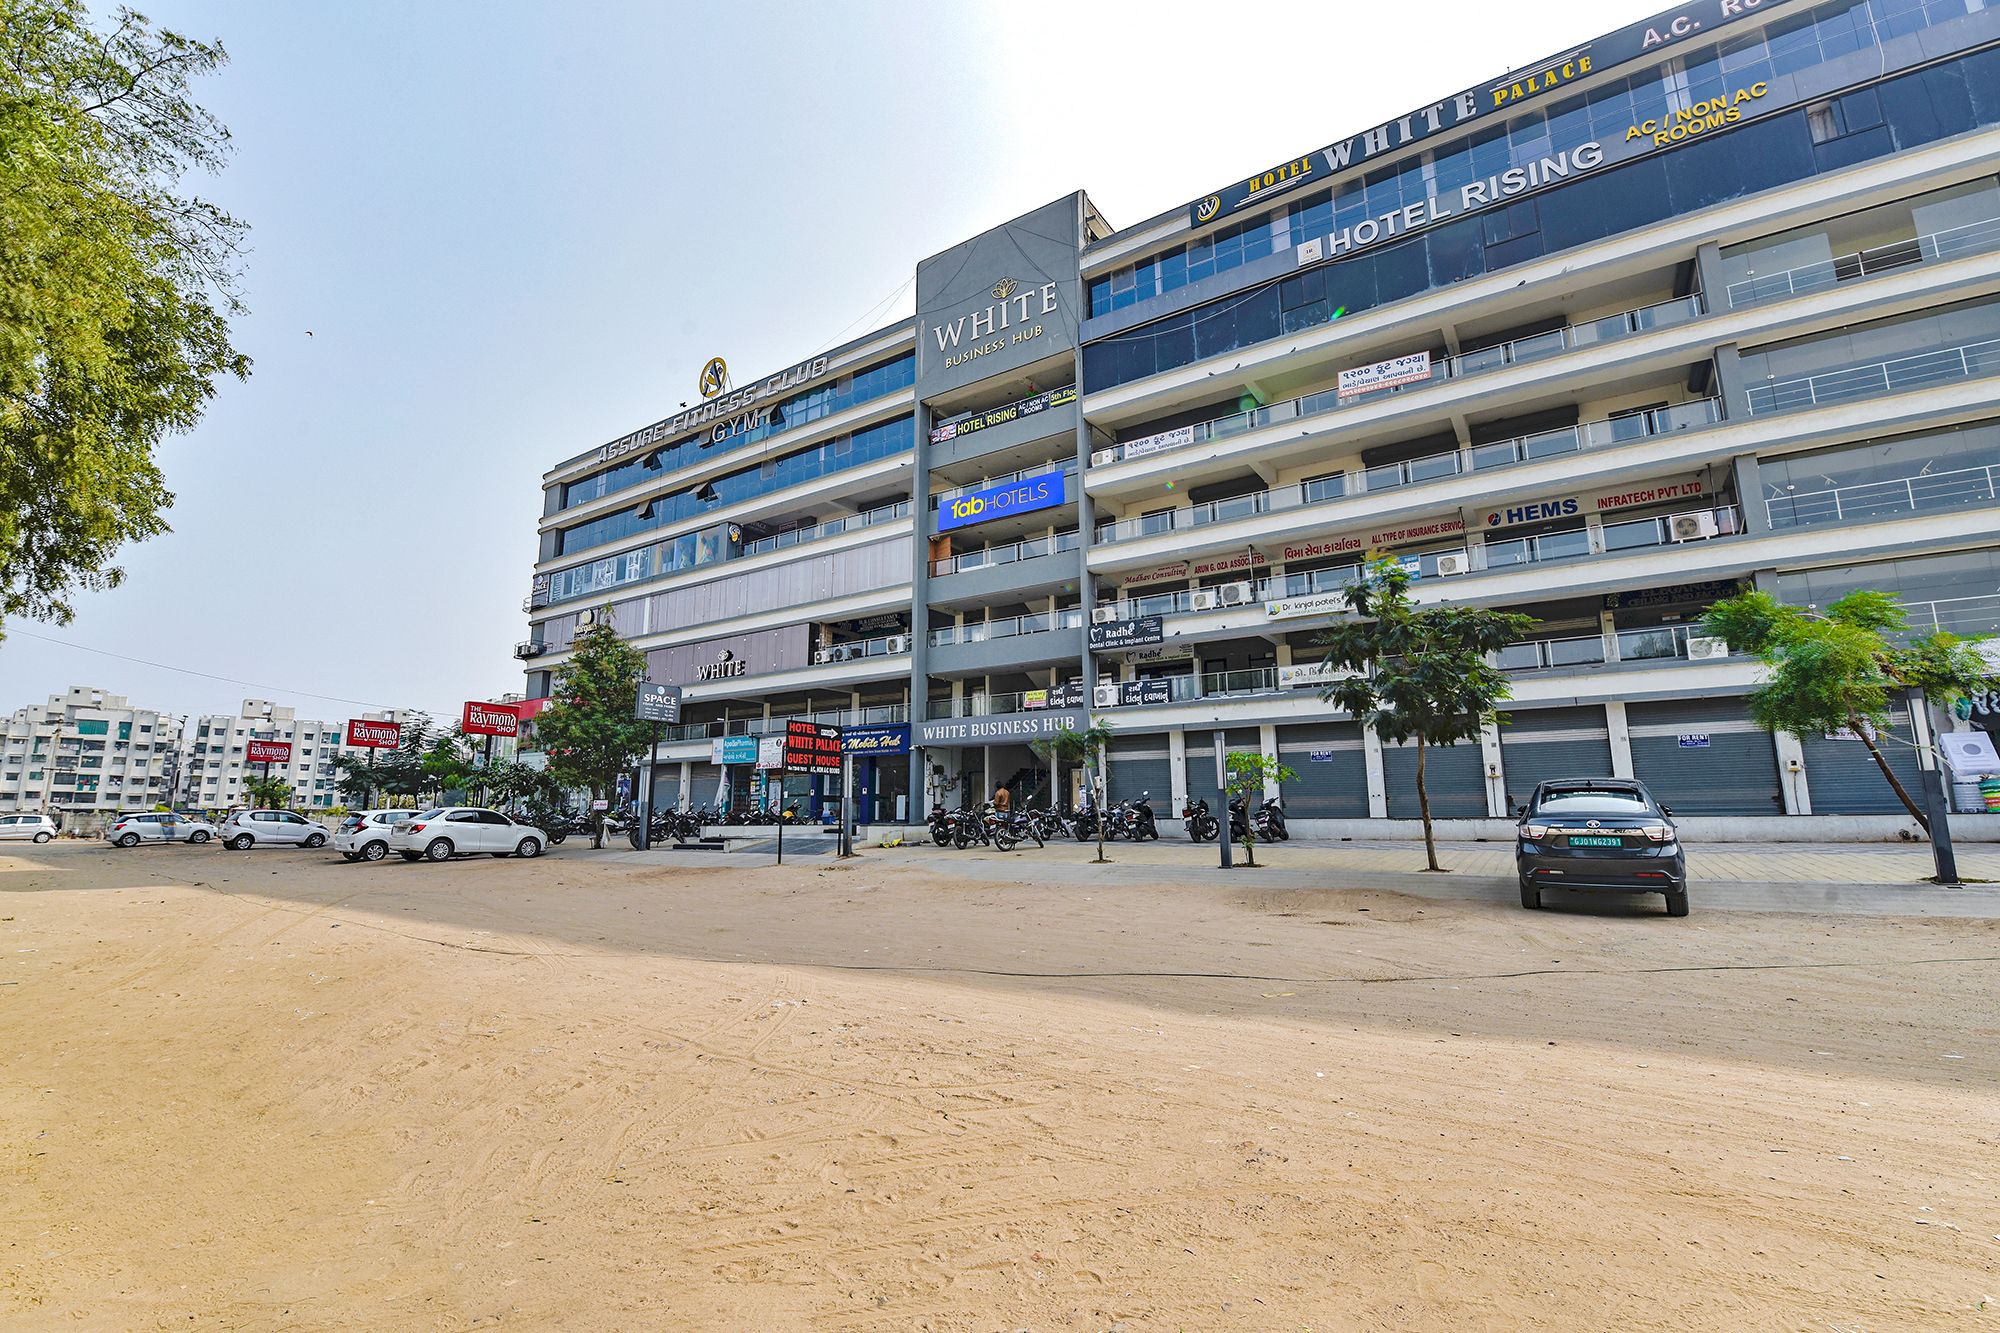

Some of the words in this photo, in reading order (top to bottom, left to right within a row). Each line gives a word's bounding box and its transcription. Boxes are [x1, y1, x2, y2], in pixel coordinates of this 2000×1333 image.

[1643, 16, 1700, 48] A.C.
[1625, 118, 1656, 142] AC
[1676, 94, 1728, 126] NON
[1733, 81, 1768, 105] AC
[1248, 157, 1312, 194] HOTEL
[1321, 91, 1477, 171] WHITE
[1493, 55, 1592, 108] PALACE
[1652, 106, 1742, 147] ROOMS
[1329, 196, 1452, 256] HOTEL
[1461, 141, 1604, 210] RISING
[933, 281, 1057, 351] WHITE
[945, 338, 1005, 369] BUSINESS
[1012, 325, 1043, 345] HUB
[1343, 367, 1371, 380] ૧૨૦૦
[1029, 399, 1041, 408] NON
[1051, 393, 1062, 401] 5th
[598, 422, 666, 463] ASSURE
[671, 387, 755, 434] FITNESS
[765, 356, 829, 396] CLUB
[1024, 404, 1043, 415] ROOMS
[712, 410, 760, 443] GYM
[957, 416, 986, 435] HOTEL
[987, 407, 1017, 426] RISING
[1597, 490, 1655, 509] INFRATECH
[1657, 486, 1678, 500] PVT
[1681, 482, 1702, 495] LTD
[1506, 498, 1579, 523] HEMS
[1371, 535, 1383, 545] ALL
[1383, 532, 1397, 543] TYPE
[1398, 531, 1406, 540] OF
[1406, 524, 1439, 538] INSURANCE
[1284, 546, 1304, 560] વિમા
[1305, 543, 1322, 556] સેવા
[1324, 537, 1361, 553] કાર્યાલય
[1124, 573, 1151, 584] Madhav
[1152, 567, 1187, 580] Consulting
[1194, 564, 1210, 575] ARUN
[1217, 561, 1228, 571] OZA
[1089, 641, 1105, 649] Dental
[1124, 637, 1144, 645] Implant
[697, 660, 743, 680] WHITE
[644, 693, 677, 705] SPACE
[470, 712, 516, 728] Raymond
[789, 722, 817, 734] HOTEL
[923, 724, 967, 740] WHITE
[971, 719, 1039, 736] BUSINESS
[1043, 715, 1075, 731] HUB
[353, 727, 398, 741] Raymond
[788, 735, 813, 750] WHITE
[815, 738, 840, 752] PALACE
[848, 737, 878, 749] Mobile
[880, 735, 901, 747] Hub
[251, 746, 289, 757] Raymond
[787, 753, 813, 764] GUEST
[815, 755, 840, 767] HOUSE
